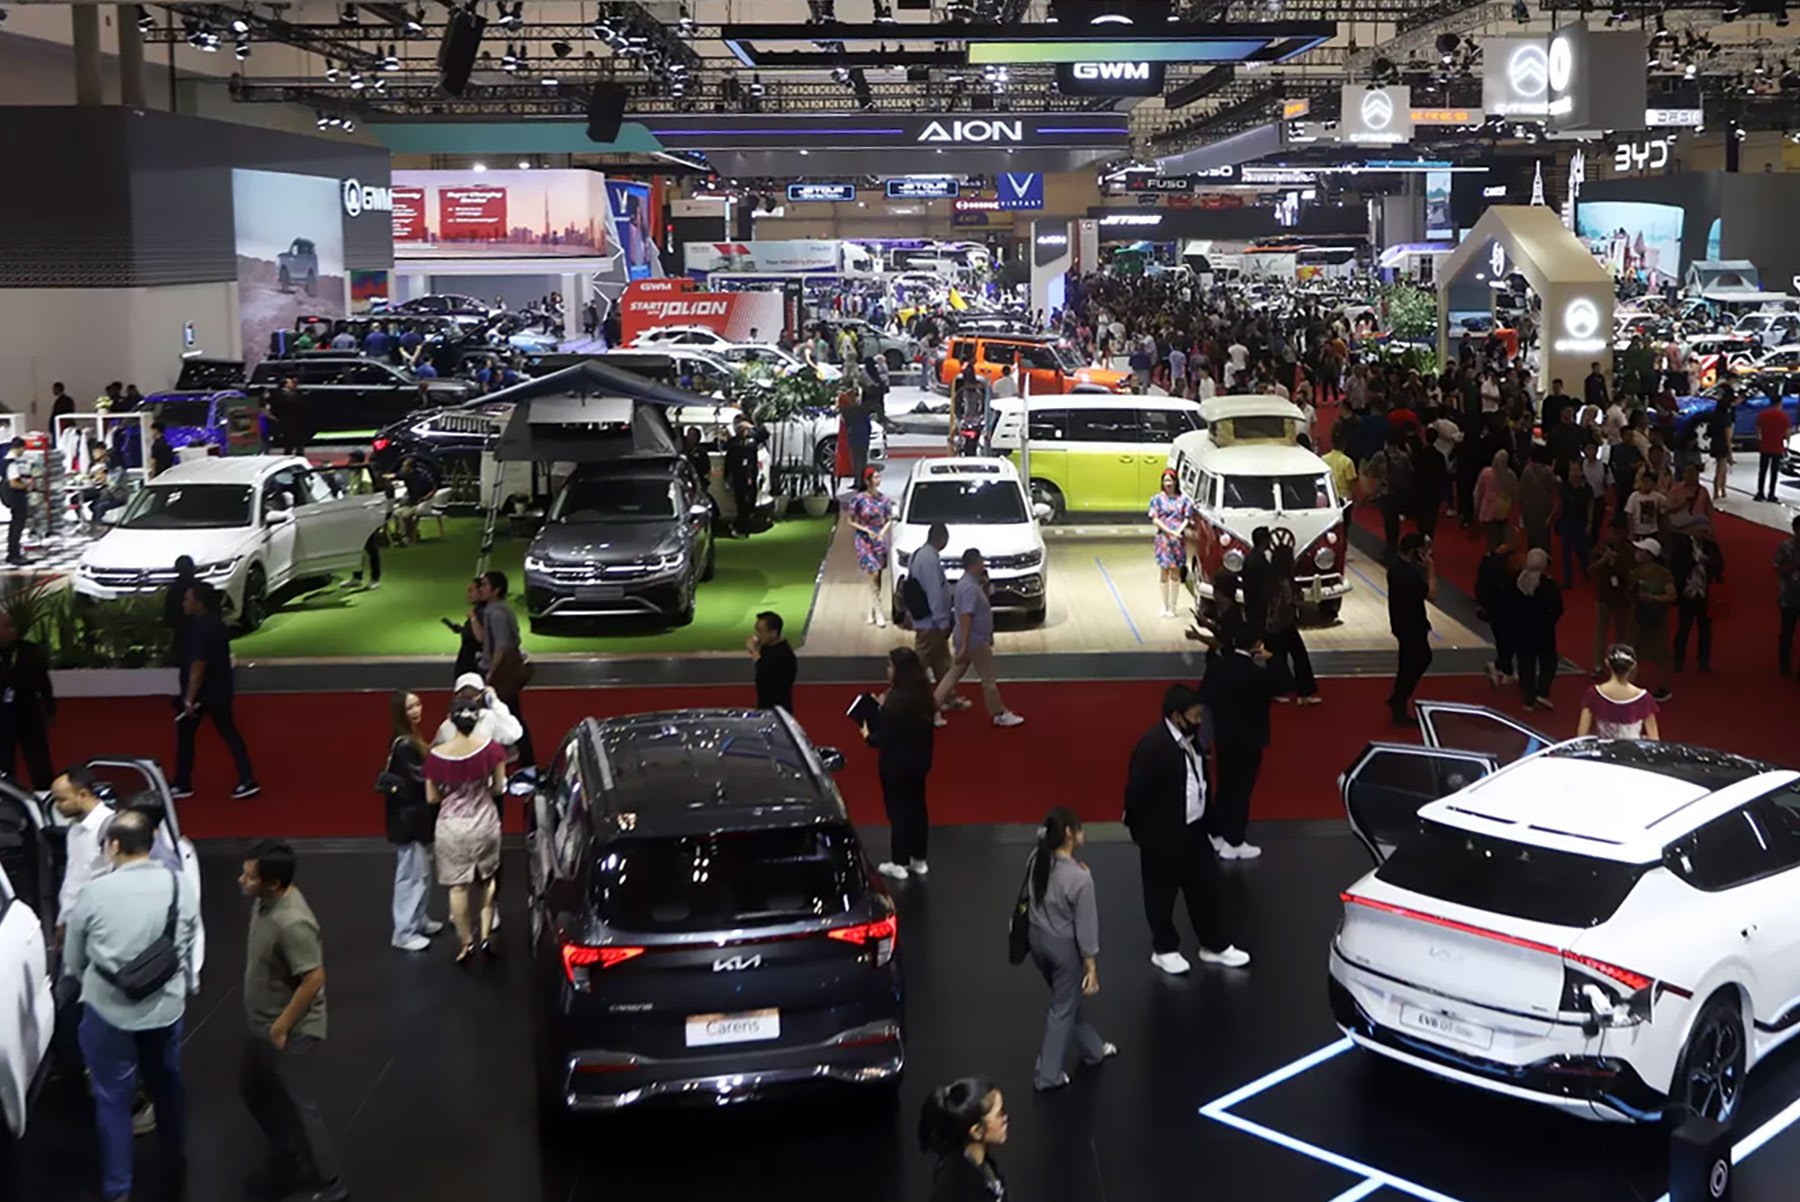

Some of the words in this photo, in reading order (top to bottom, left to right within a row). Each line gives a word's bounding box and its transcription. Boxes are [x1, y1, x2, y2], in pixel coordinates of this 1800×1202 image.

[1073, 62, 1149, 80] GWM
[917, 120, 1022, 141] AION
[1614, 140, 1668, 171] BYD
[1147, 179, 1187, 188] FUSO
[630, 302, 663, 311] START
[659, 301, 728, 319] JOLION
[706, 1019, 759, 1036] Carens
